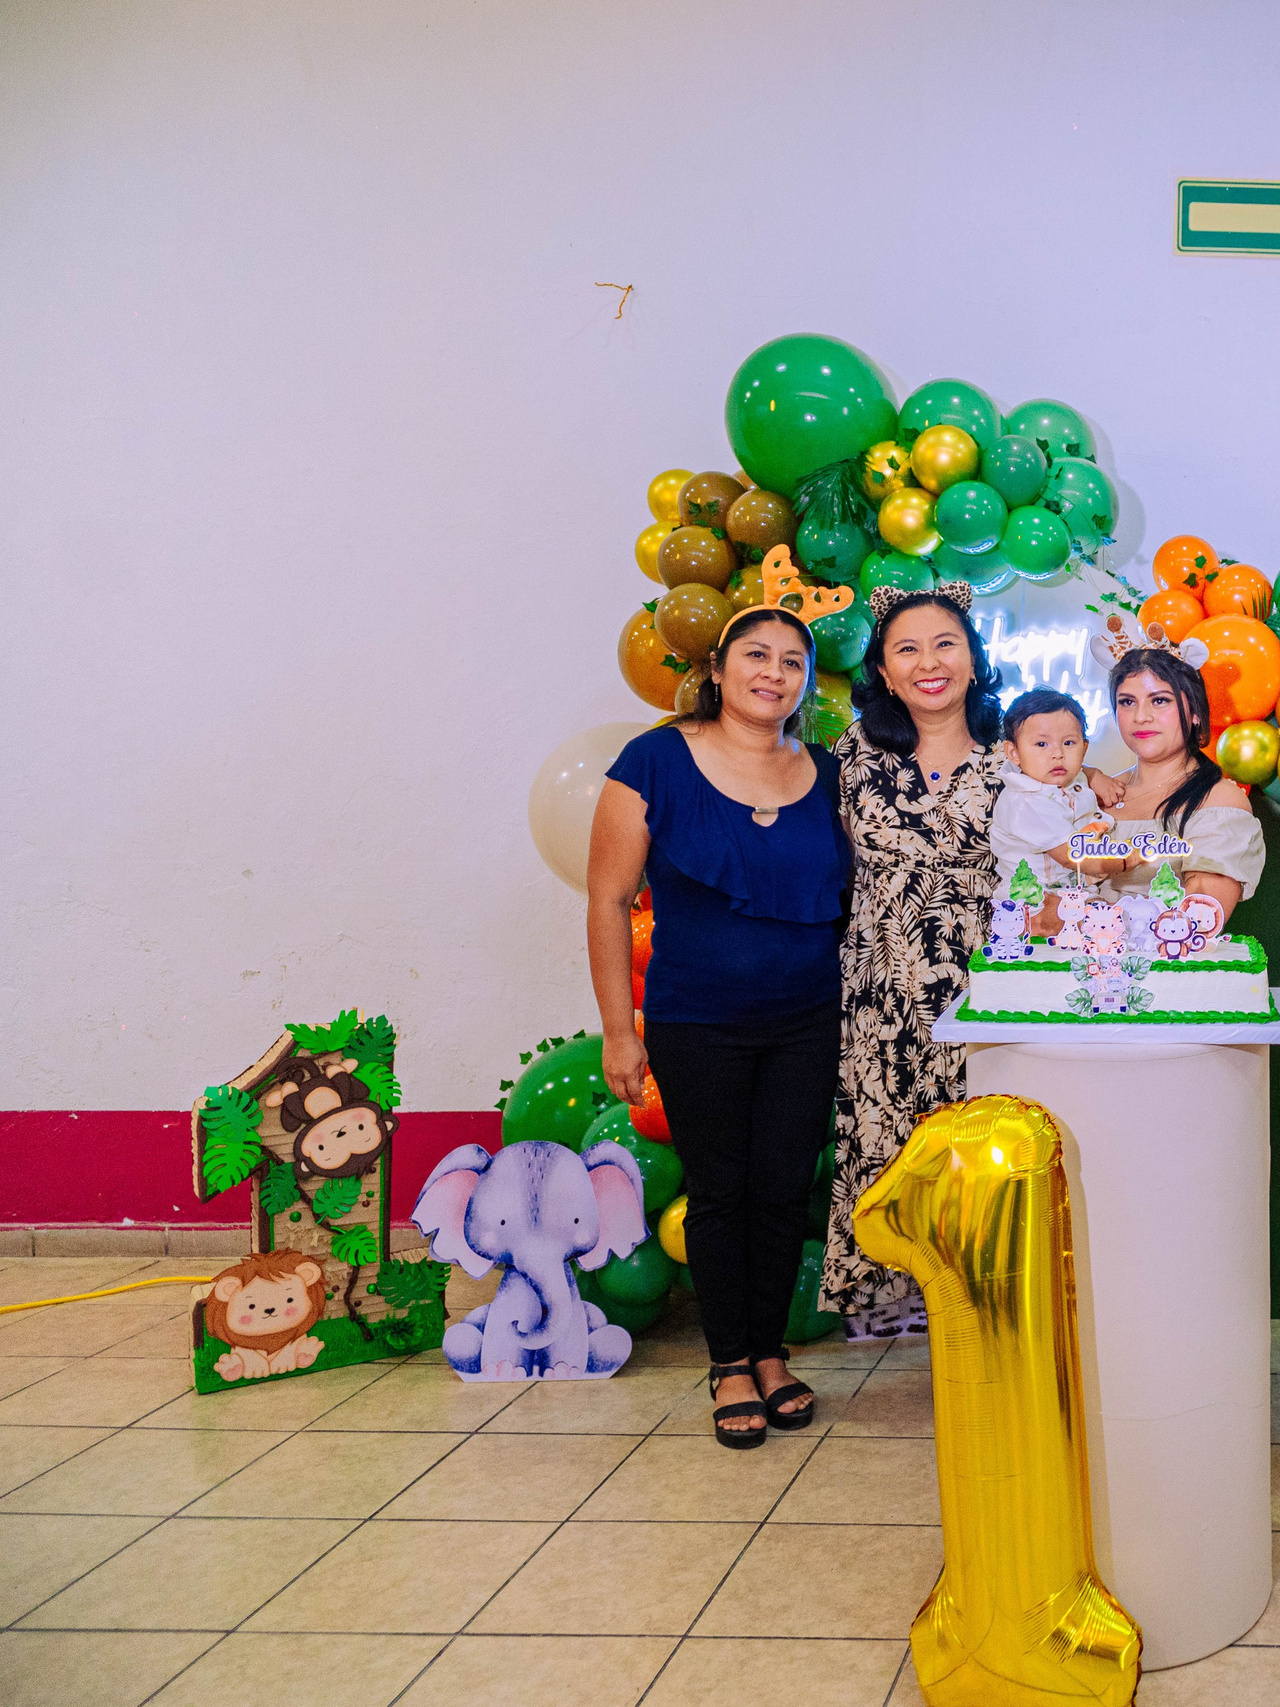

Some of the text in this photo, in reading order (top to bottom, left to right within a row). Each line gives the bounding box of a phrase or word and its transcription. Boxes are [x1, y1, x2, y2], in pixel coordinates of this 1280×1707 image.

[975, 616, 1088, 683] Happy
[1070, 833, 1191, 859] Tadeo Edén
